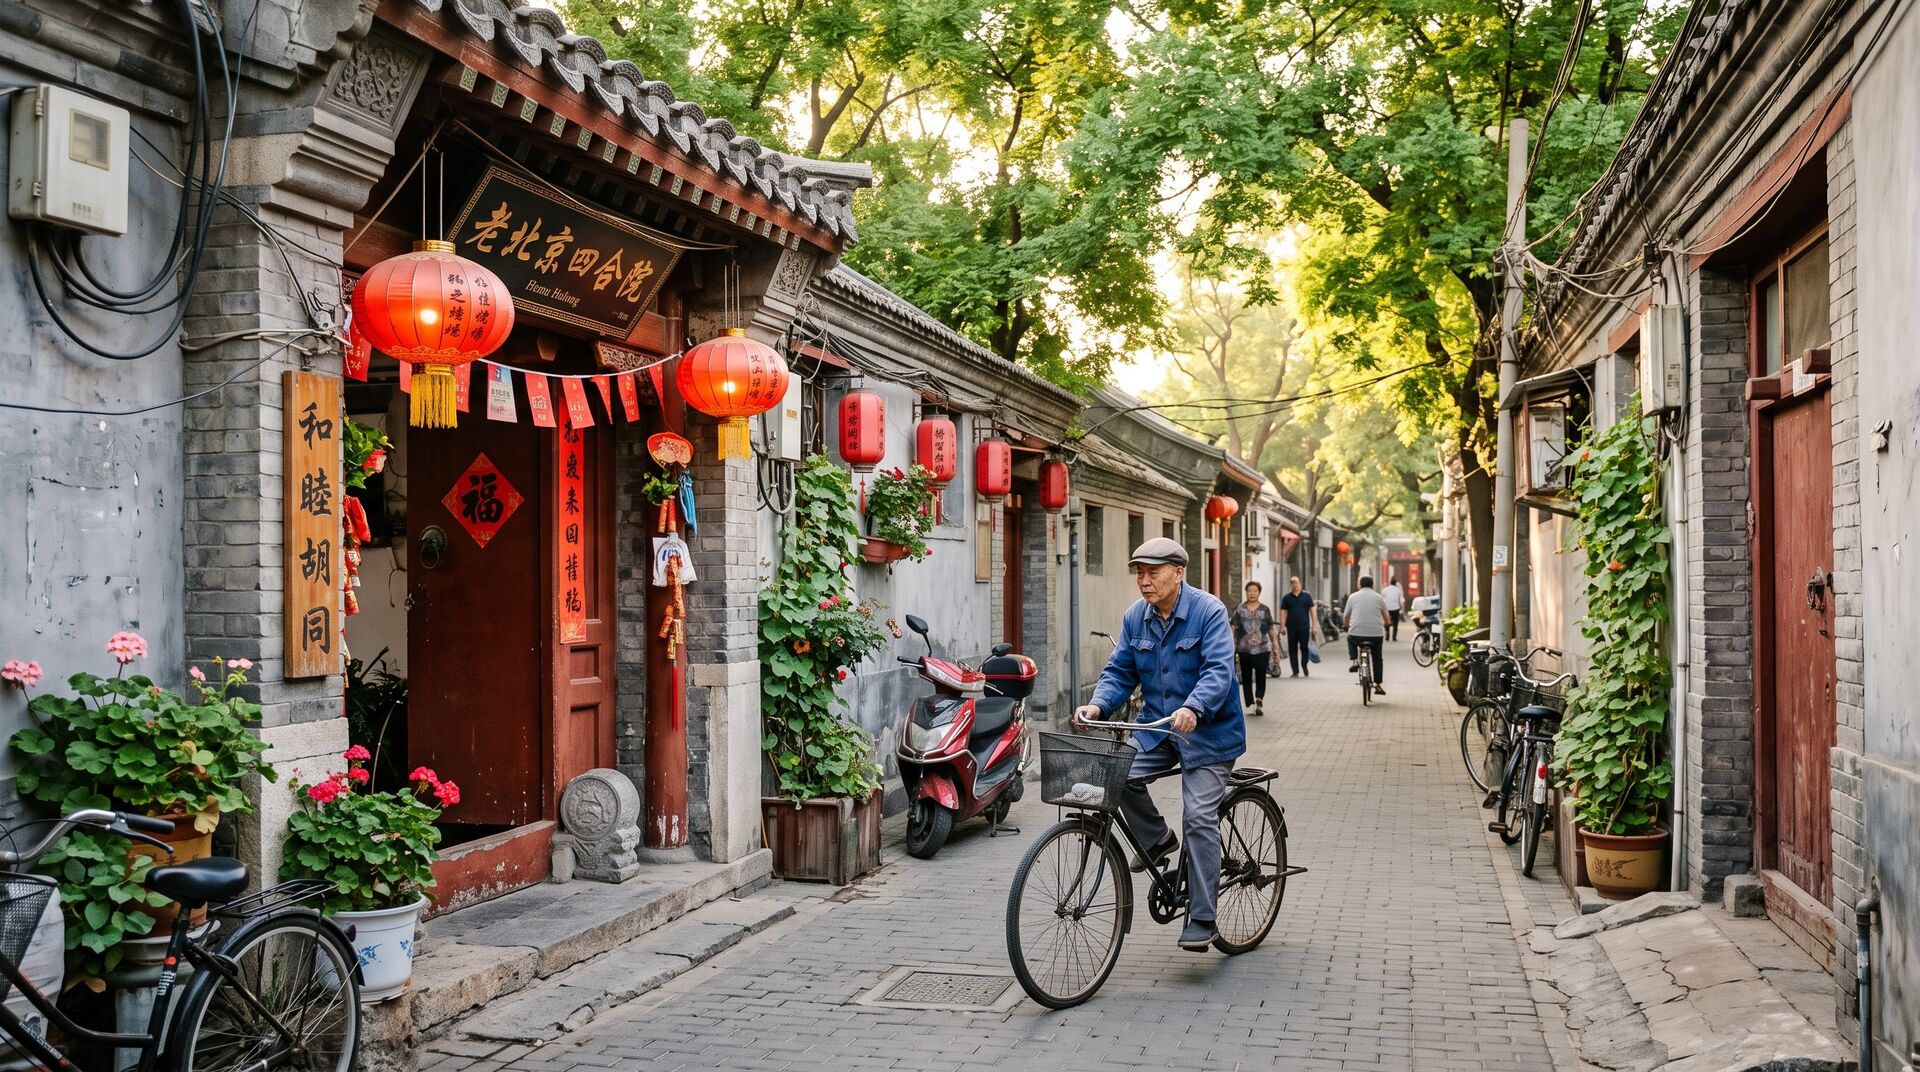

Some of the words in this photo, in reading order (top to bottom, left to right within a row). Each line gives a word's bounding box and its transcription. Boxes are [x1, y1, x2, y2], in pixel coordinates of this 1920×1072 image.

[465, 201, 653, 303] 老北京四合院
[299, 402, 333, 654] 和睦胡同
[461, 472, 505, 524] 福
